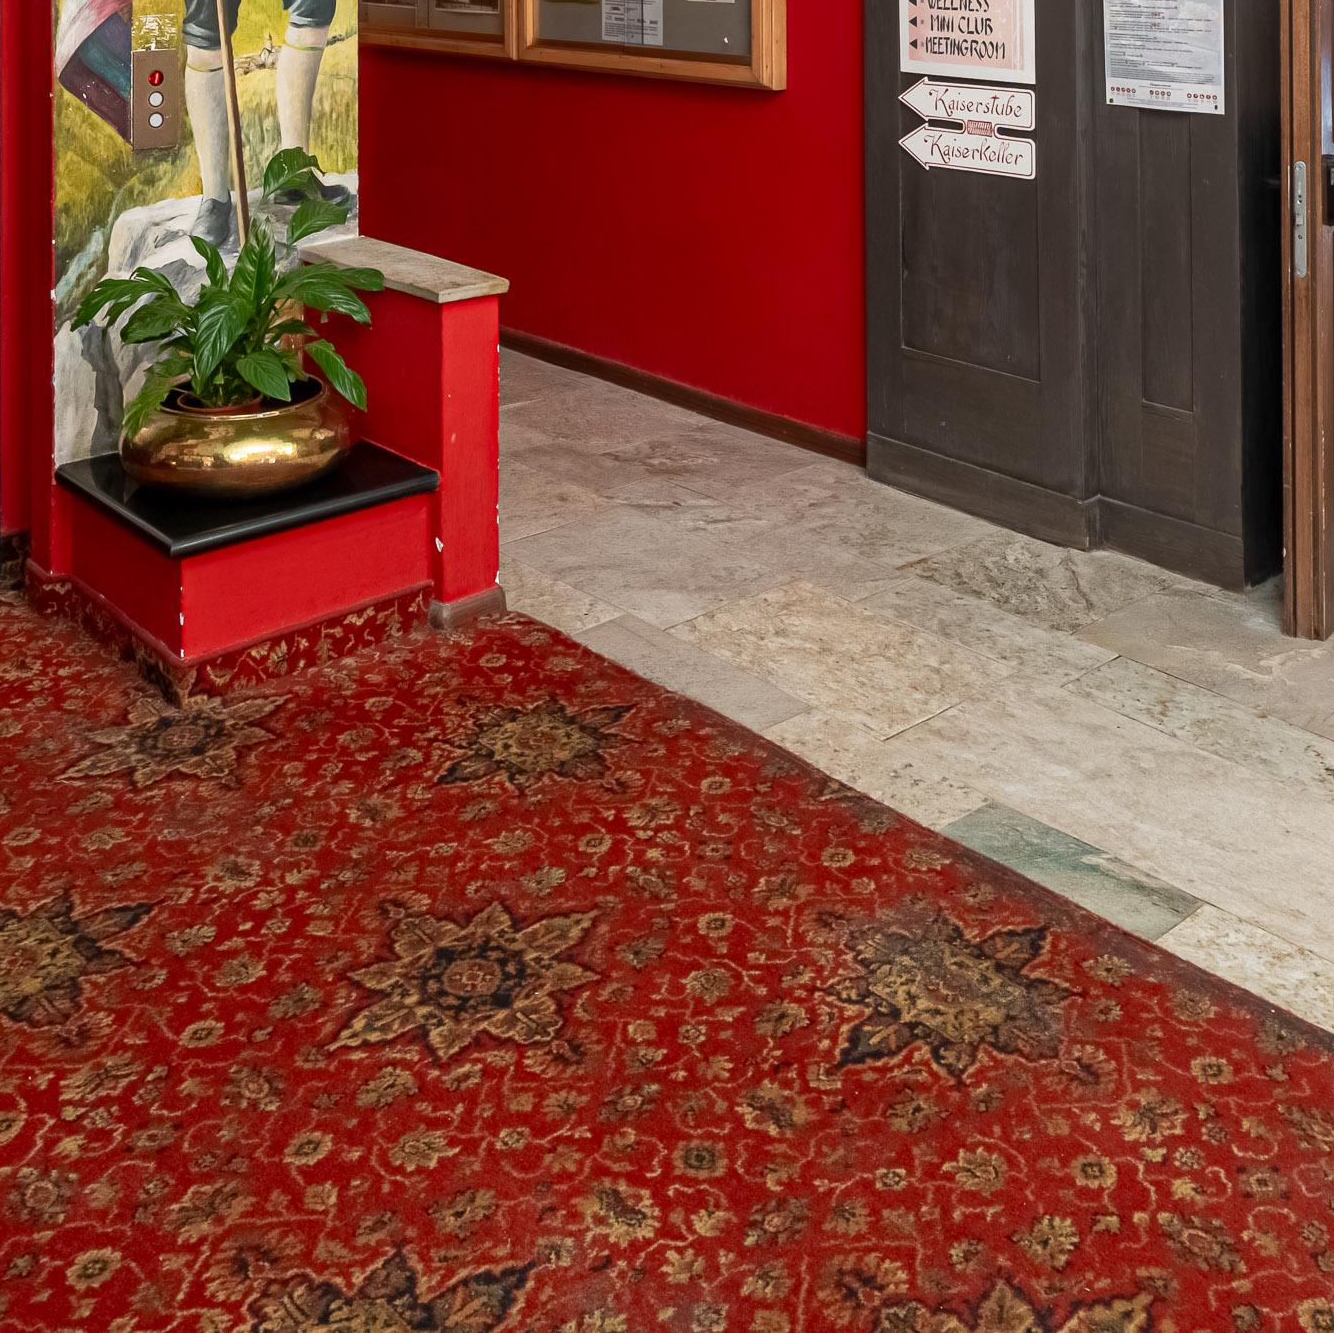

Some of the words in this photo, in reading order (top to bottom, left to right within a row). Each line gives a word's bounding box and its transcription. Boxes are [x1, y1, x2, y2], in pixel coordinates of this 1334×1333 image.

[930, 14, 954, 32] MINI
[957, 16, 994, 36] CLUB
[928, 88, 1022, 118] Kaiserstube
[923, 134, 1024, 165] Kaiserkeller
